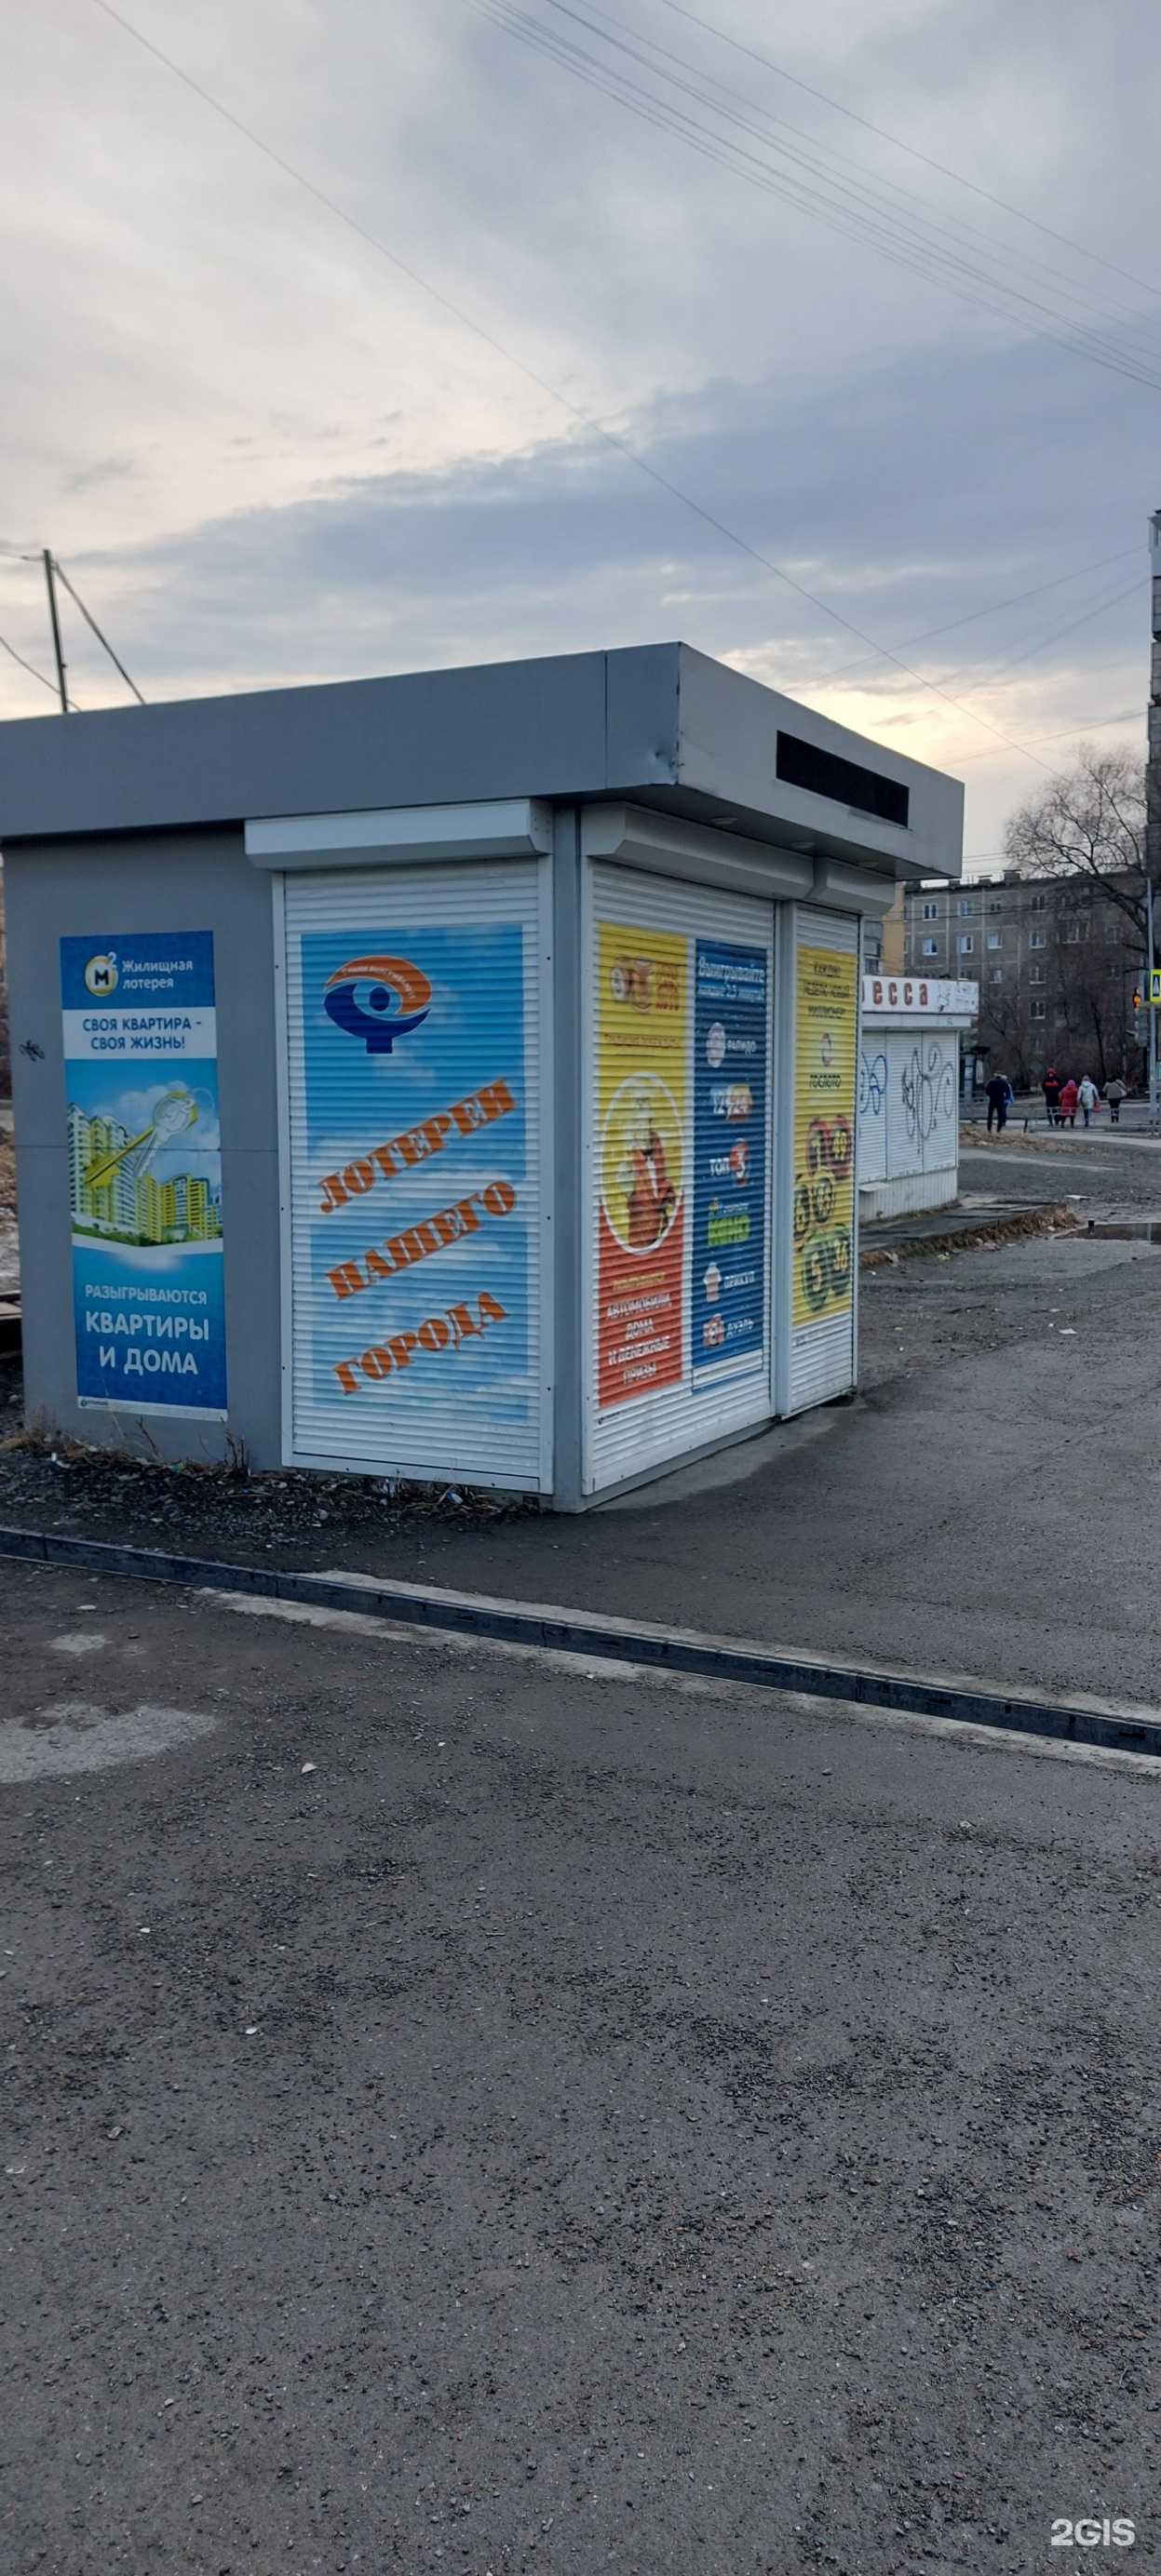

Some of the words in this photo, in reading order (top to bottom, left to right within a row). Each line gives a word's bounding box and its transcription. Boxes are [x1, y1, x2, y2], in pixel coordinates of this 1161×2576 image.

[122, 959, 194, 973] Жилищная
[123, 978, 174, 991] лотерея
[862, 980, 927, 1006] есса
[83, 1018, 117, 1032] СВОЯ
[122, 1017, 192, 1031] КВАРТИРА
[91, 1037, 126, 1050] СВОЯ
[130, 1036, 186, 1050] ЖИЗНЬ!
[317, 1078, 518, 1214] ЛОТЕРЕИ
[709, 1158, 730, 1175] ТОП
[326, 1181, 518, 1301] НАШЕГО
[85, 1284, 207, 1305] РАЗЫГРЫВАЮТСЯ
[86, 1310, 209, 1341] КВАРТИРЫ
[625, 1318, 655, 1341] ДОМА
[332, 1290, 510, 1395] ГОРОДА
[100, 1346, 115, 1368] И
[124, 1348, 198, 1376] ДОМА
